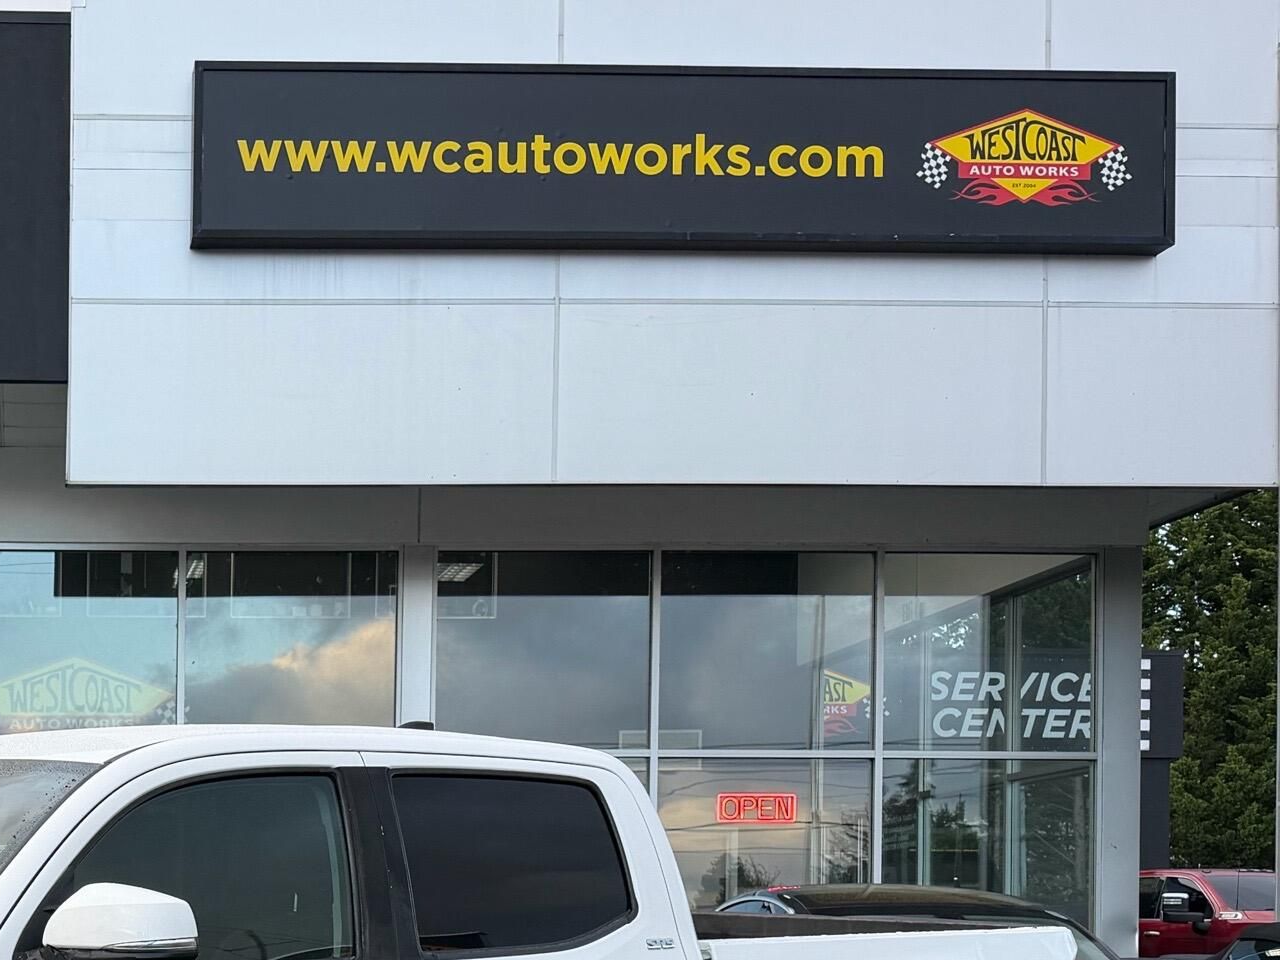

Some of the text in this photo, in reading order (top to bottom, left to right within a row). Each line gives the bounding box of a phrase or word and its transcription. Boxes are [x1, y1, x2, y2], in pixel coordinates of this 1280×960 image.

[236, 132, 884, 179] www.wcautoworks.com
[969, 165, 1080, 177] AUTO WORKS
[931, 670, 1092, 702] SERVICE
[9, 716, 134, 730] AUTO WORKS
[932, 707, 1091, 738] CENTER
[722, 796, 792, 820] OPEN
